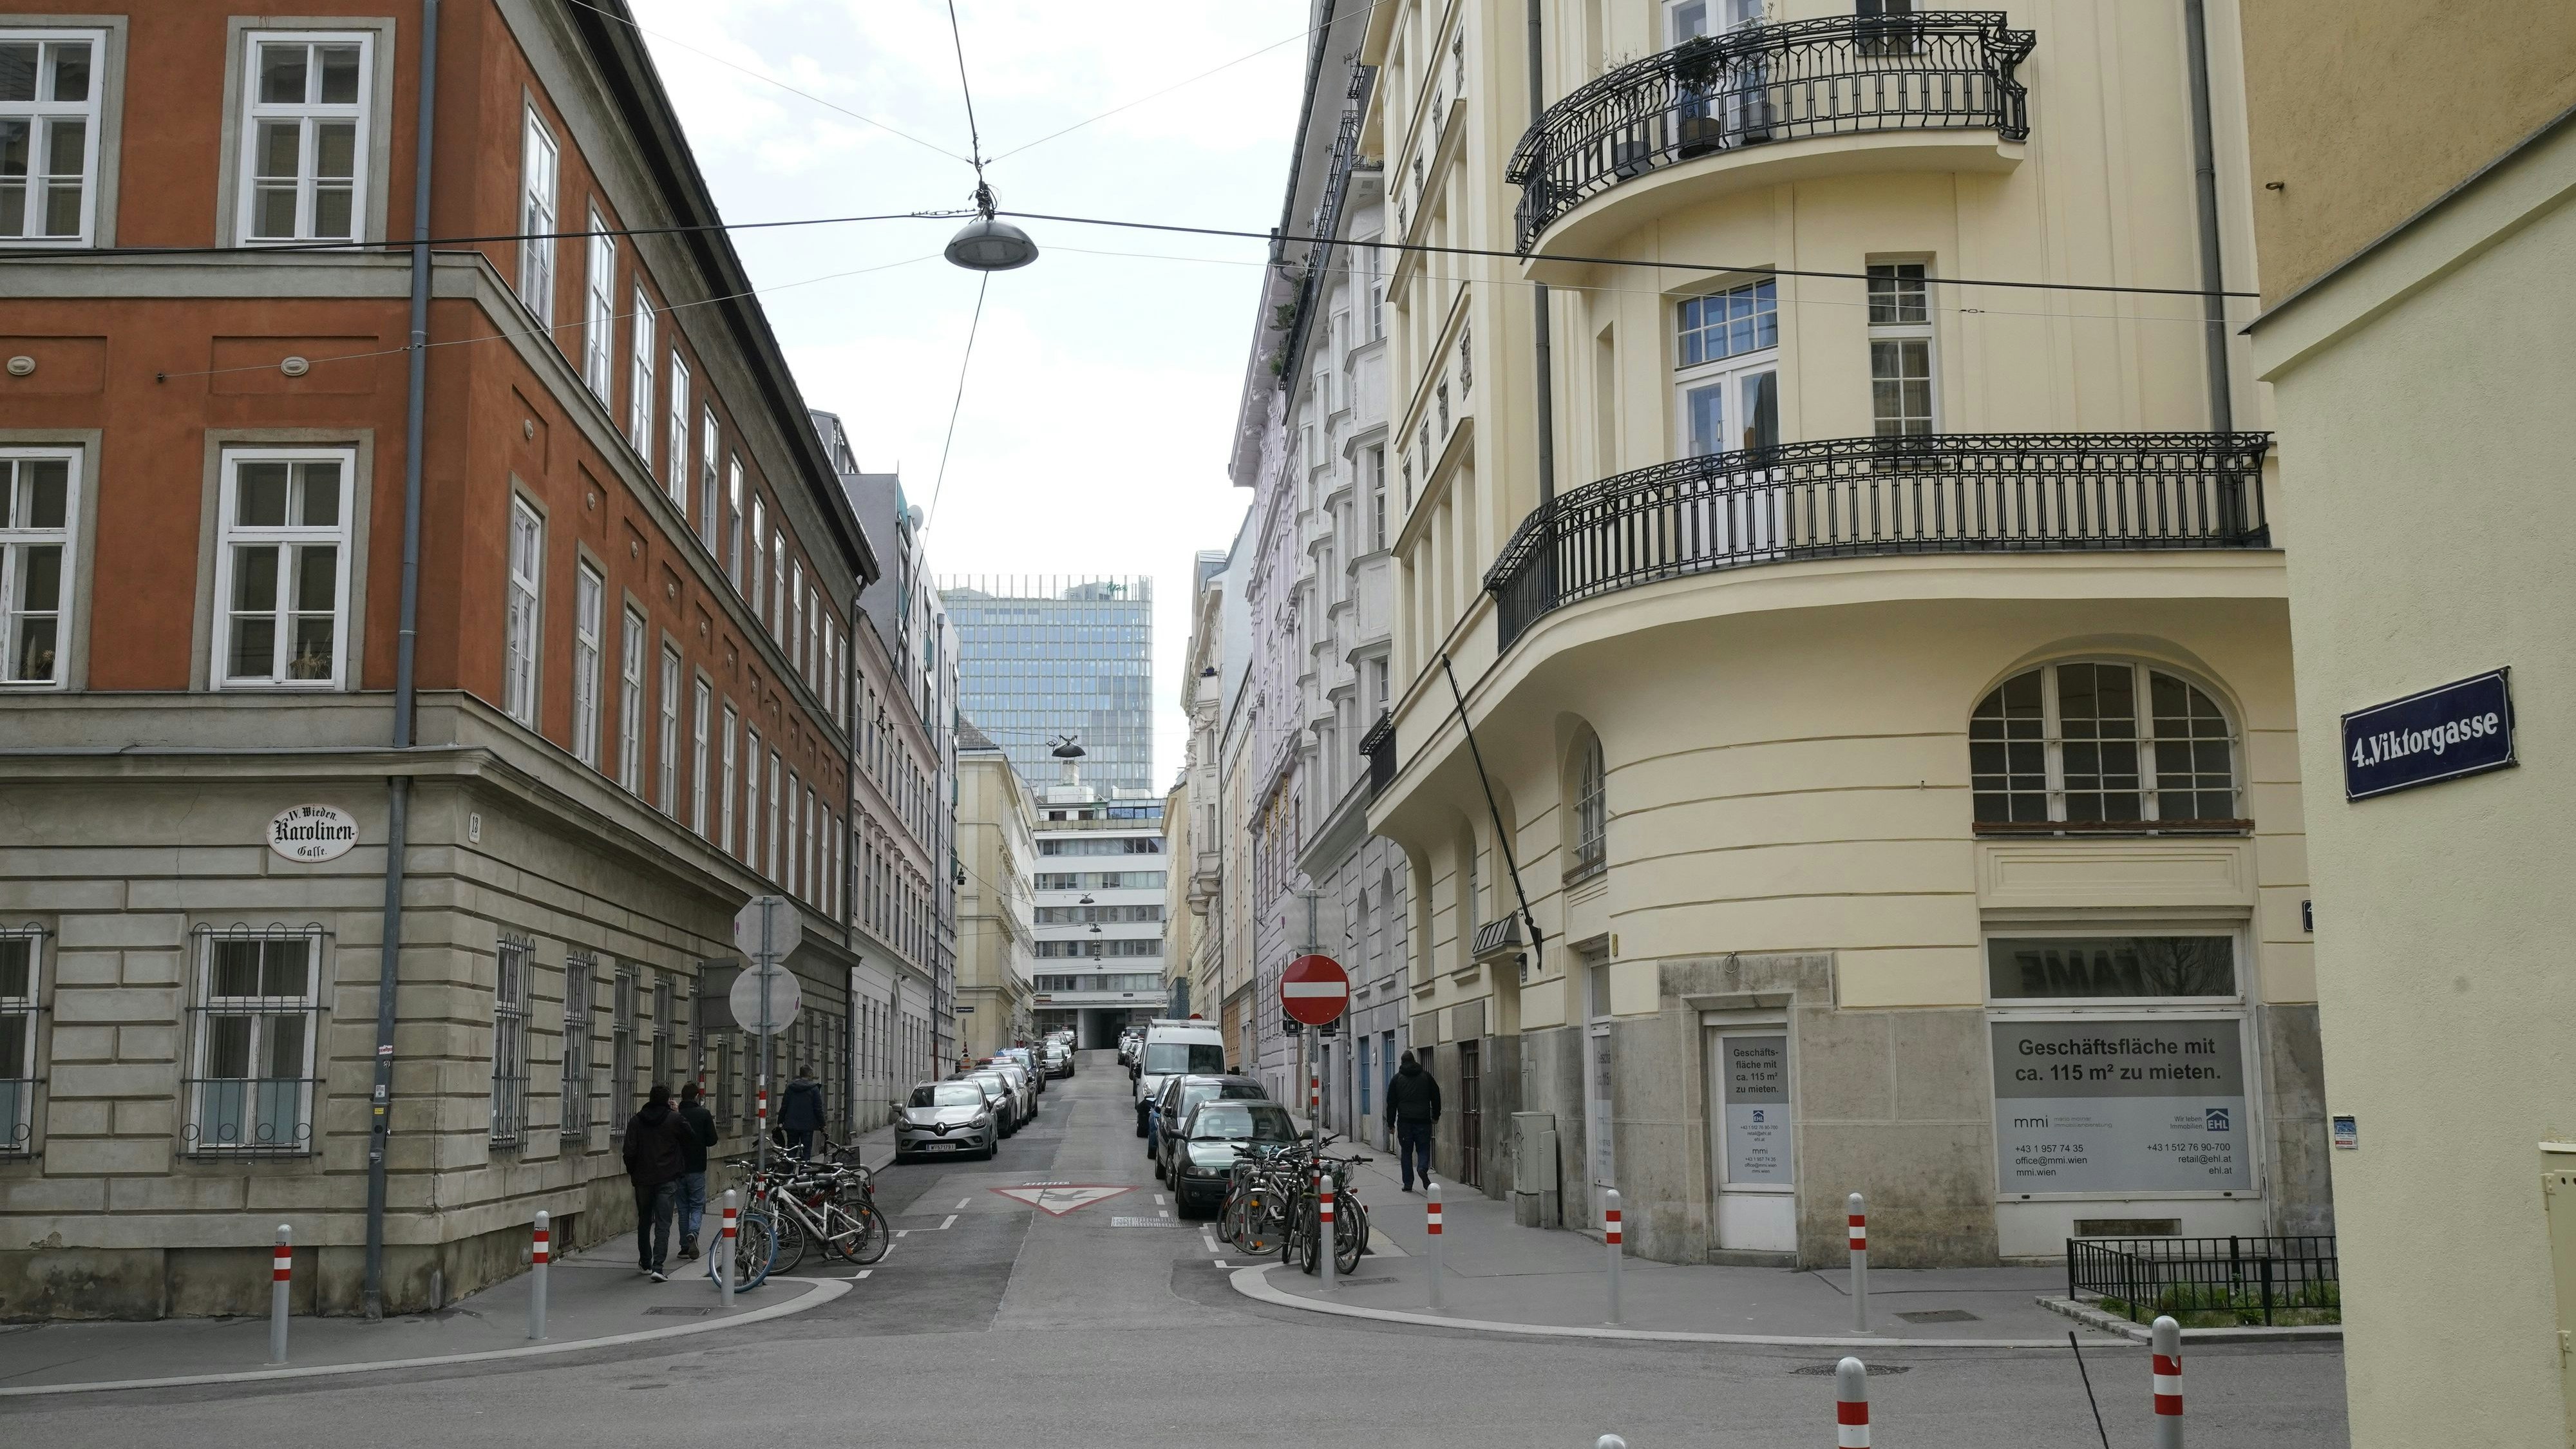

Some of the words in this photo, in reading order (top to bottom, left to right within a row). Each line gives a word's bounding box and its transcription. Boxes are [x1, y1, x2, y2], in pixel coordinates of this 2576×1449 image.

[289, 810, 301, 821] IV.
[302, 807, 337, 821] Wieden.
[471, 816, 478, 833] 13
[274, 818, 355, 844] Karolinen-
[2018, 1038, 2178, 1056] Geschäftsfläche
[2184, 1037, 2215, 1054] mit
[1734, 1048, 1779, 1057] Geschäfts-
[1736, 1061, 1761, 1069] fläche
[1751, 1072, 1765, 1081] 115
[2015, 1068, 2043, 1081] ca.
[2050, 1064, 2083, 1081] 115
[2120, 1068, 2143, 1080] zu
[2150, 1063, 2221, 1080] mieten.
[1748, 1084, 1779, 1093] mieten.
[2014, 1115, 2049, 1128] mmi
[2208, 1119, 2228, 1129] EHL
[2041, 1144, 2057, 1153] 957
[2060, 1144, 2070, 1153] 74
[2072, 1144, 2084, 1152] 35
[2172, 1143, 2186, 1151] 512
[2188, 1143, 2199, 1151] 76
[2201, 1143, 2231, 1151] 90-700
[2015, 1156, 2087, 1166] office@mmi.wien
[2178, 1155, 2231, 1164] retail@ehl.at
